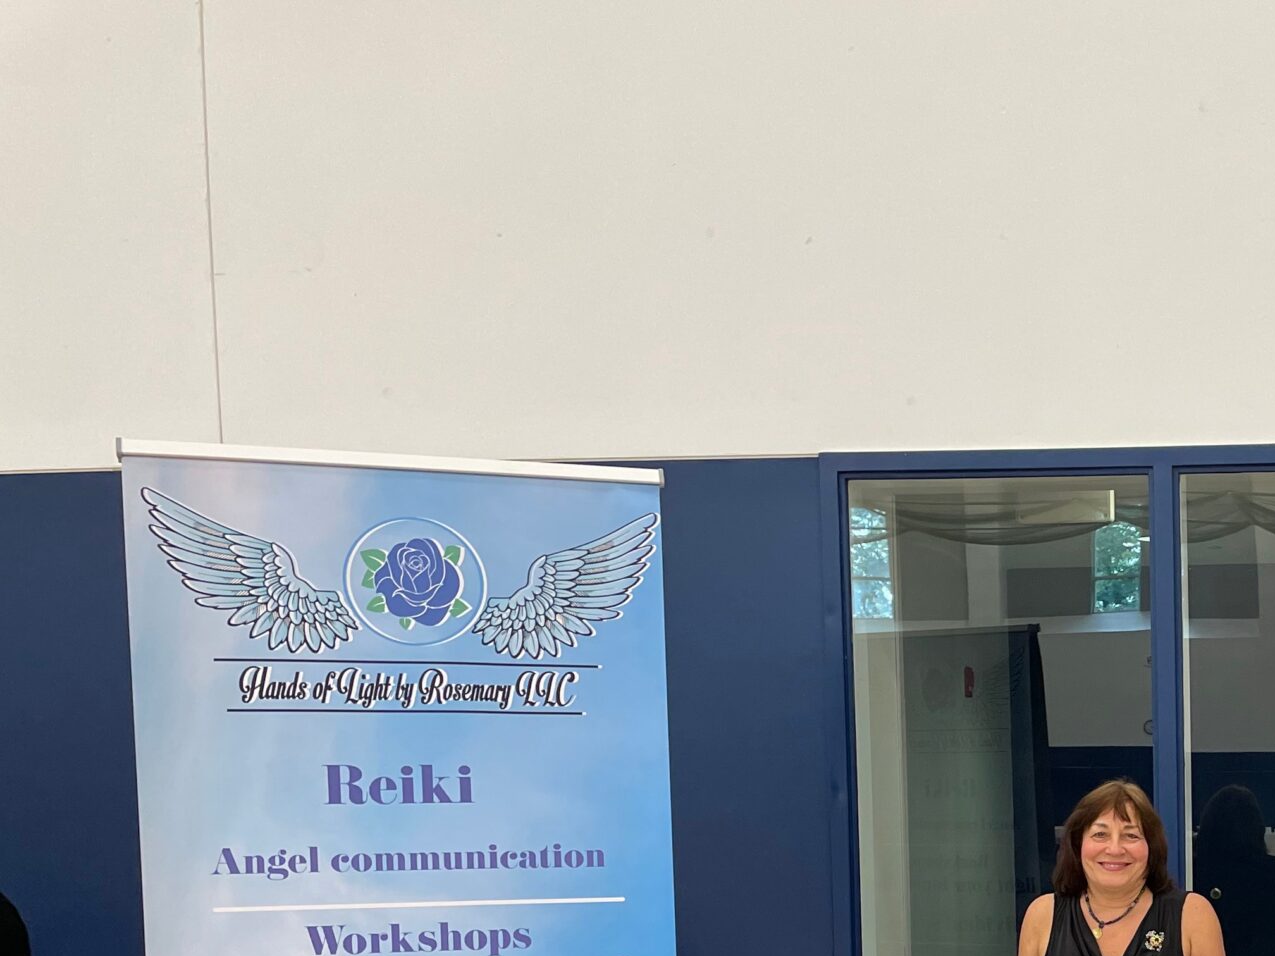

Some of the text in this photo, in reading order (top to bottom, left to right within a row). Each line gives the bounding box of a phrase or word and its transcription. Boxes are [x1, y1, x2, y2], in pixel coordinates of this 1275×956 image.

[239, 665, 576, 710] Hands of Light by Rosemary LLC
[322, 764, 475, 806] Reiki
[211, 843, 605, 880] Angel communication
[306, 922, 532, 956] Workshops
